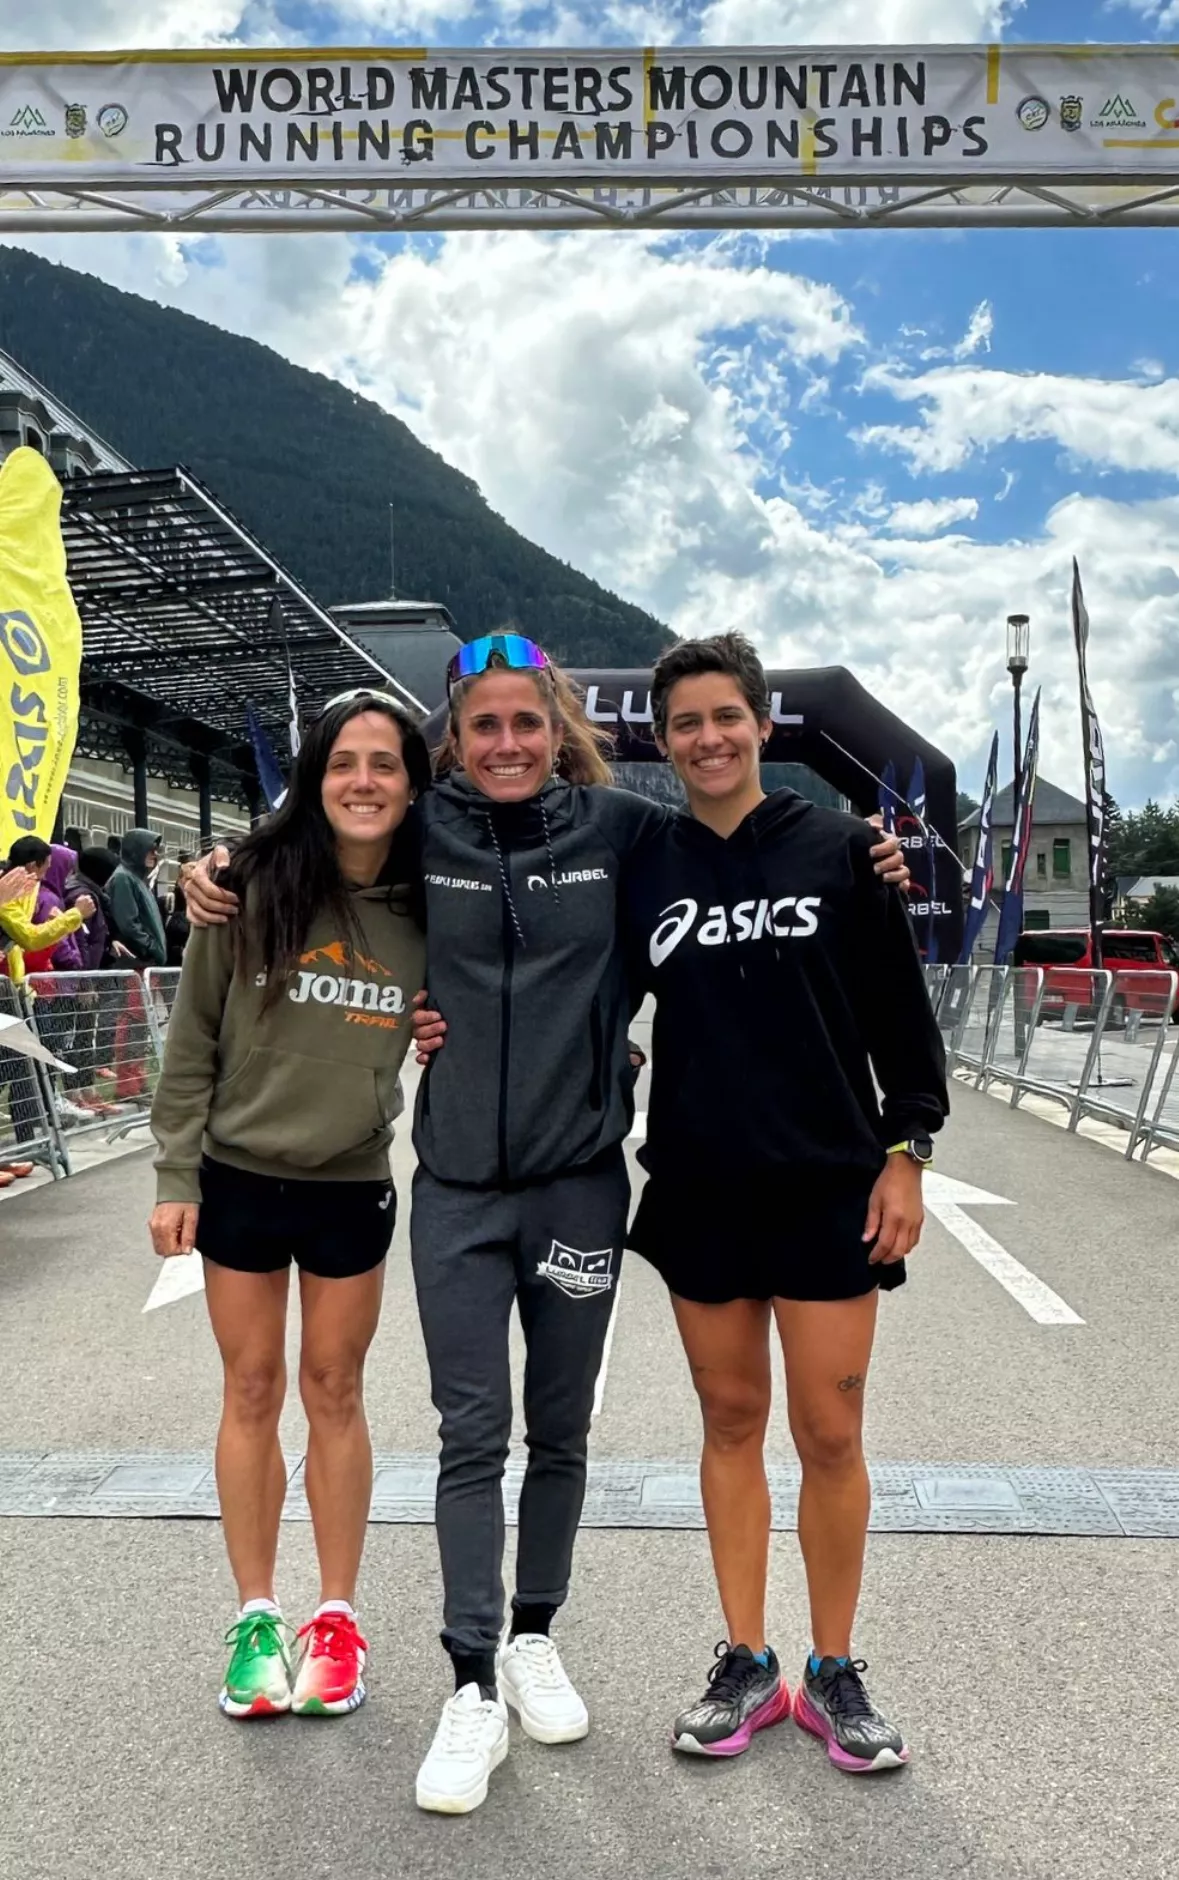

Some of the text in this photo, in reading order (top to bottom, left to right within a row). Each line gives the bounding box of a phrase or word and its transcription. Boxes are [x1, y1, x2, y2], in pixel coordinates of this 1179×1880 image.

[213, 61, 926, 116] WORLD MASTERS MOUNTAIN
[150, 115, 988, 166] RUNNING CHAMPIONSHIPS
[585, 685, 804, 724] LUL
